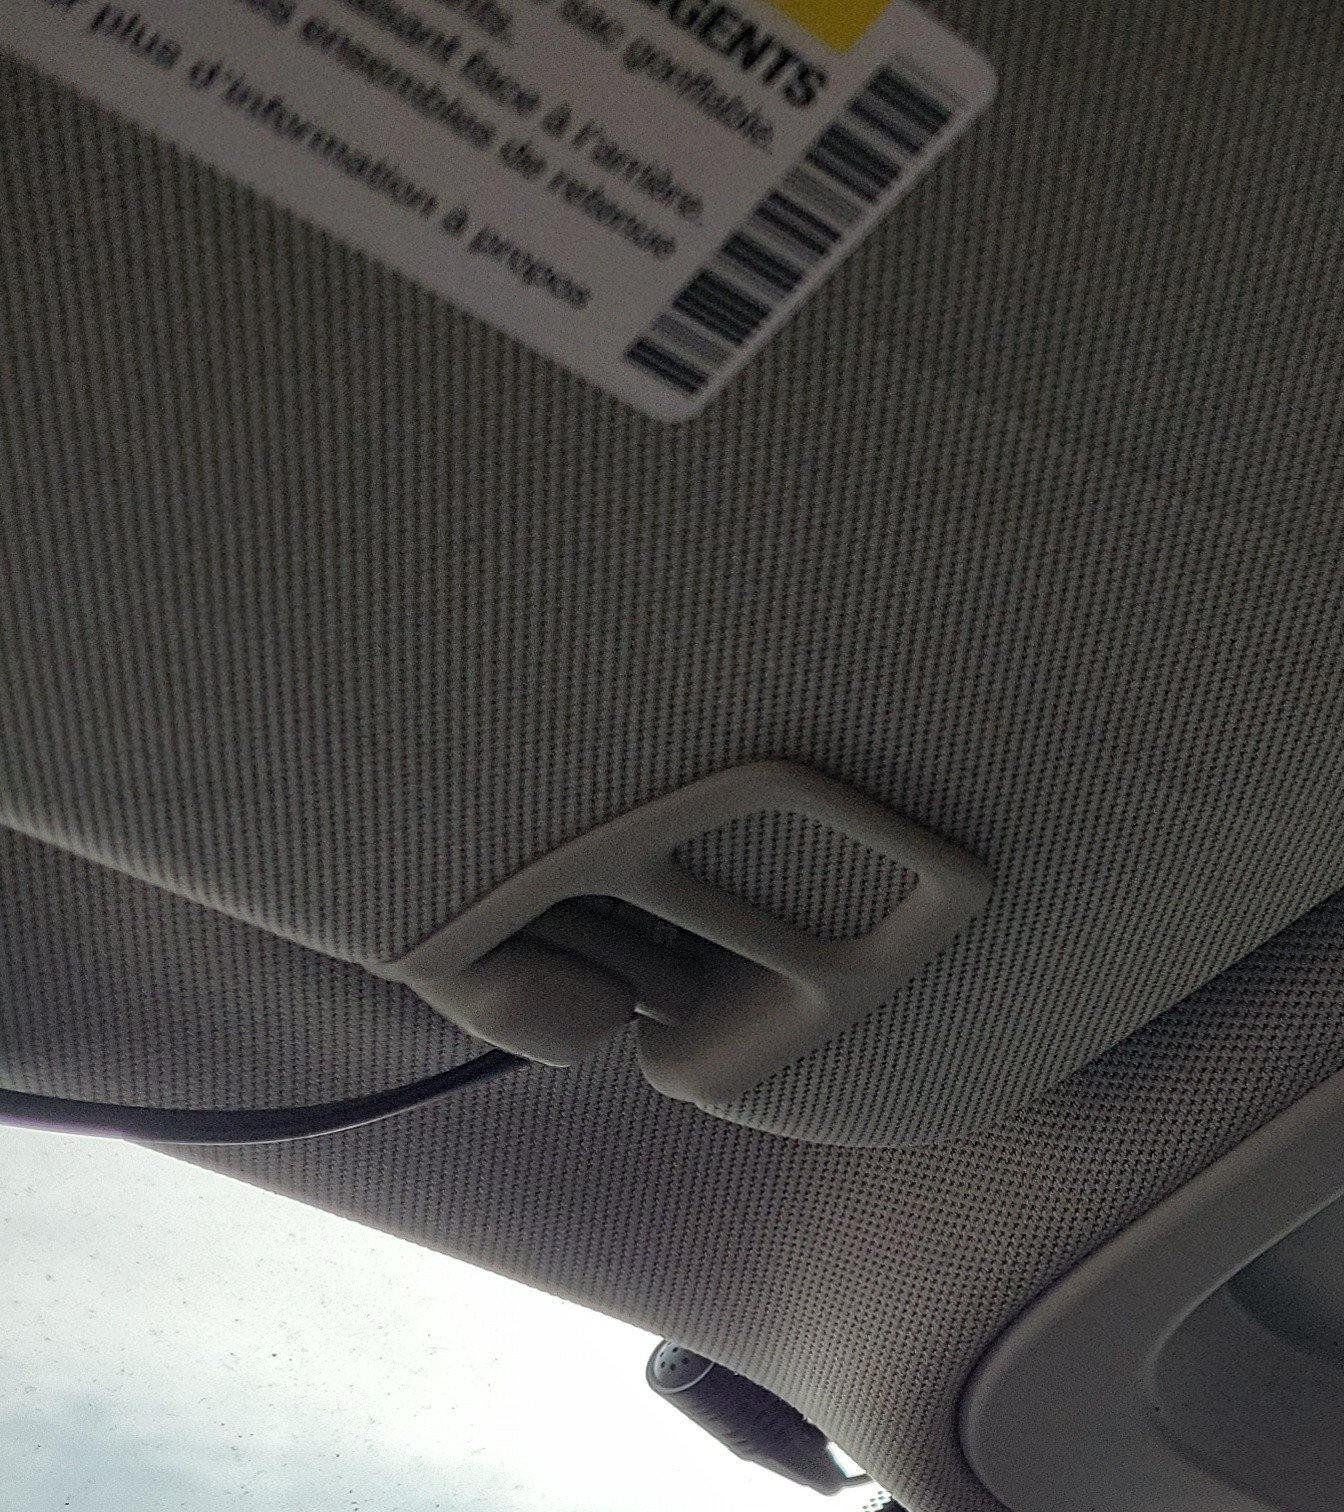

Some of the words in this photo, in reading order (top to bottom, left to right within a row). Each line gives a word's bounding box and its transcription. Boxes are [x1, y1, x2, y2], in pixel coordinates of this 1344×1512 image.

[89, 2, 183, 70] plus
[188, 57, 439, 220] d'information
[440, 204, 470, 239] à
[468, 222, 592, 311] propos
[300, 17, 497, 150] ensembles
[499, 138, 548, 181] de
[548, 170, 677, 259] retenue
